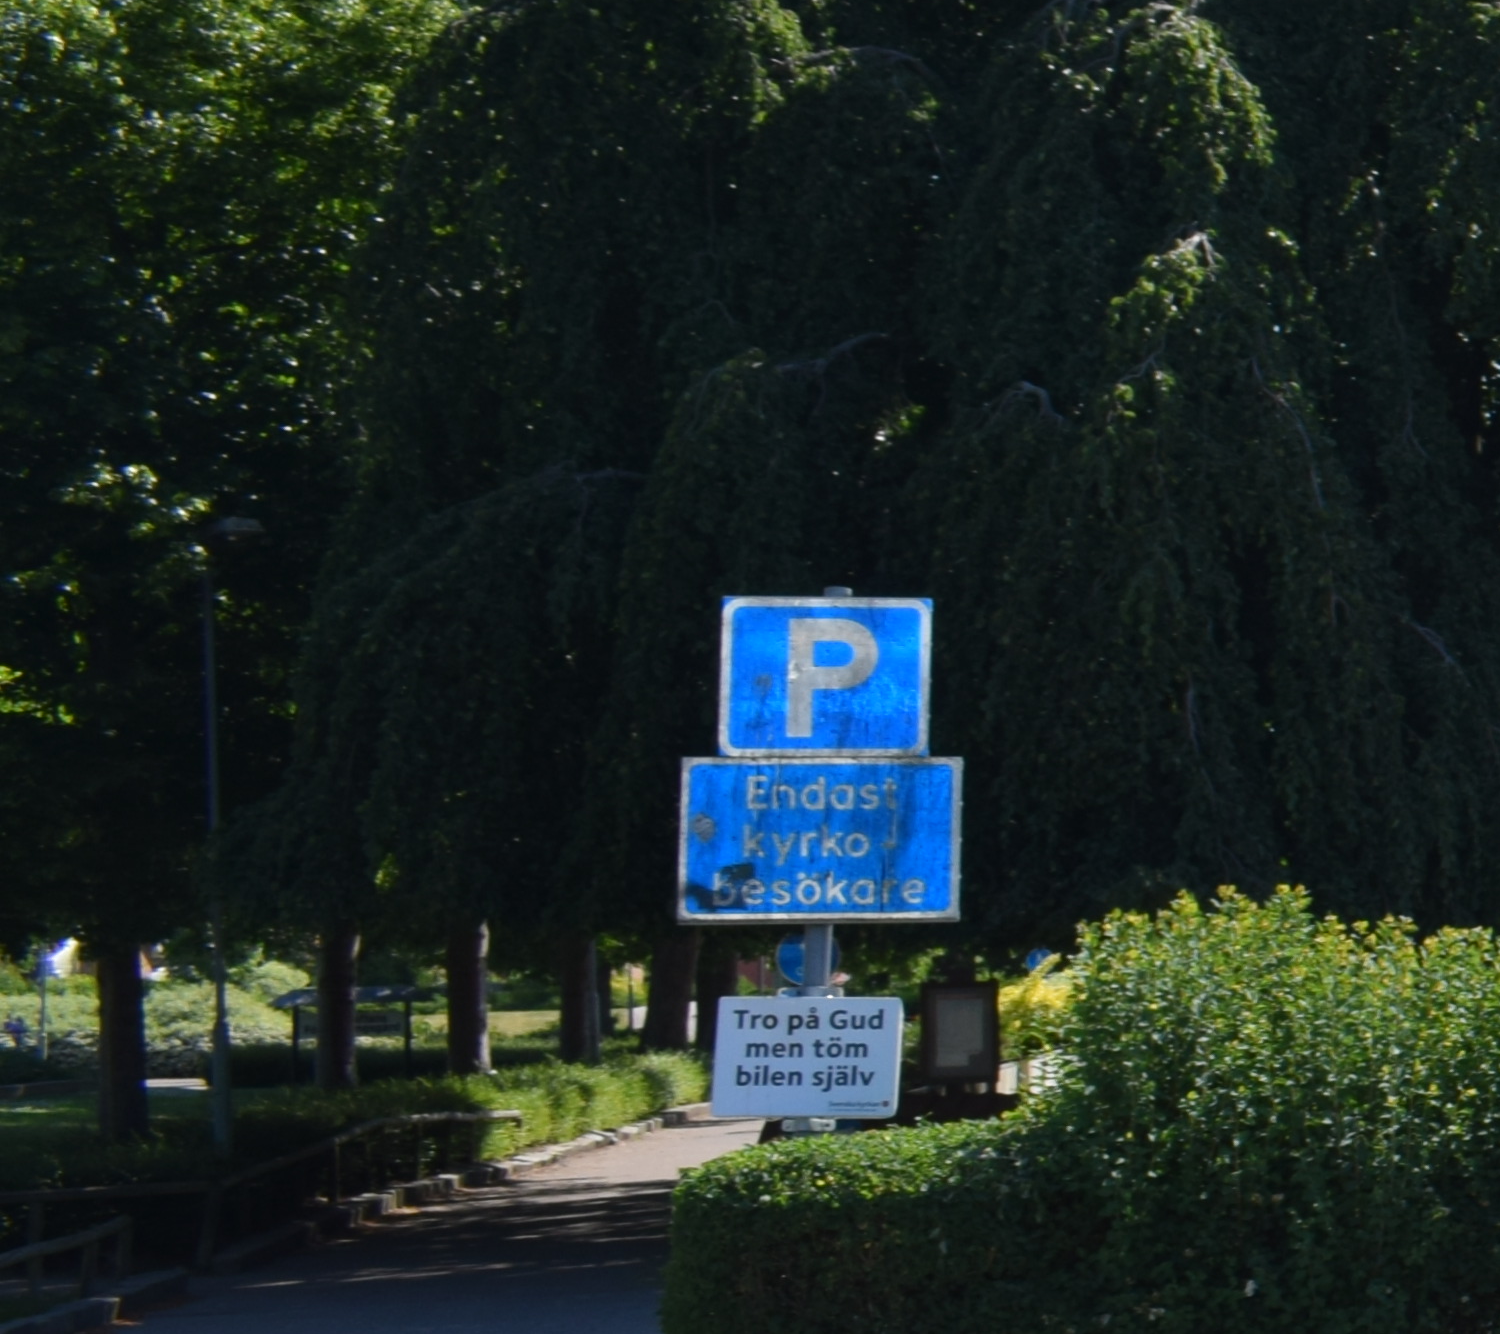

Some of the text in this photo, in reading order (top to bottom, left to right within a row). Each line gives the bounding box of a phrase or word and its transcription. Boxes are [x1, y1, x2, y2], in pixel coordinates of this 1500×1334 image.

[786, 618, 879, 738] P
[745, 774, 898, 810] Endast
[712, 870, 926, 906] besökare
[733, 1007, 884, 1035] Tro på Gud
[745, 1037, 868, 1058] men töm
[736, 1065, 875, 1092] bilen själv
